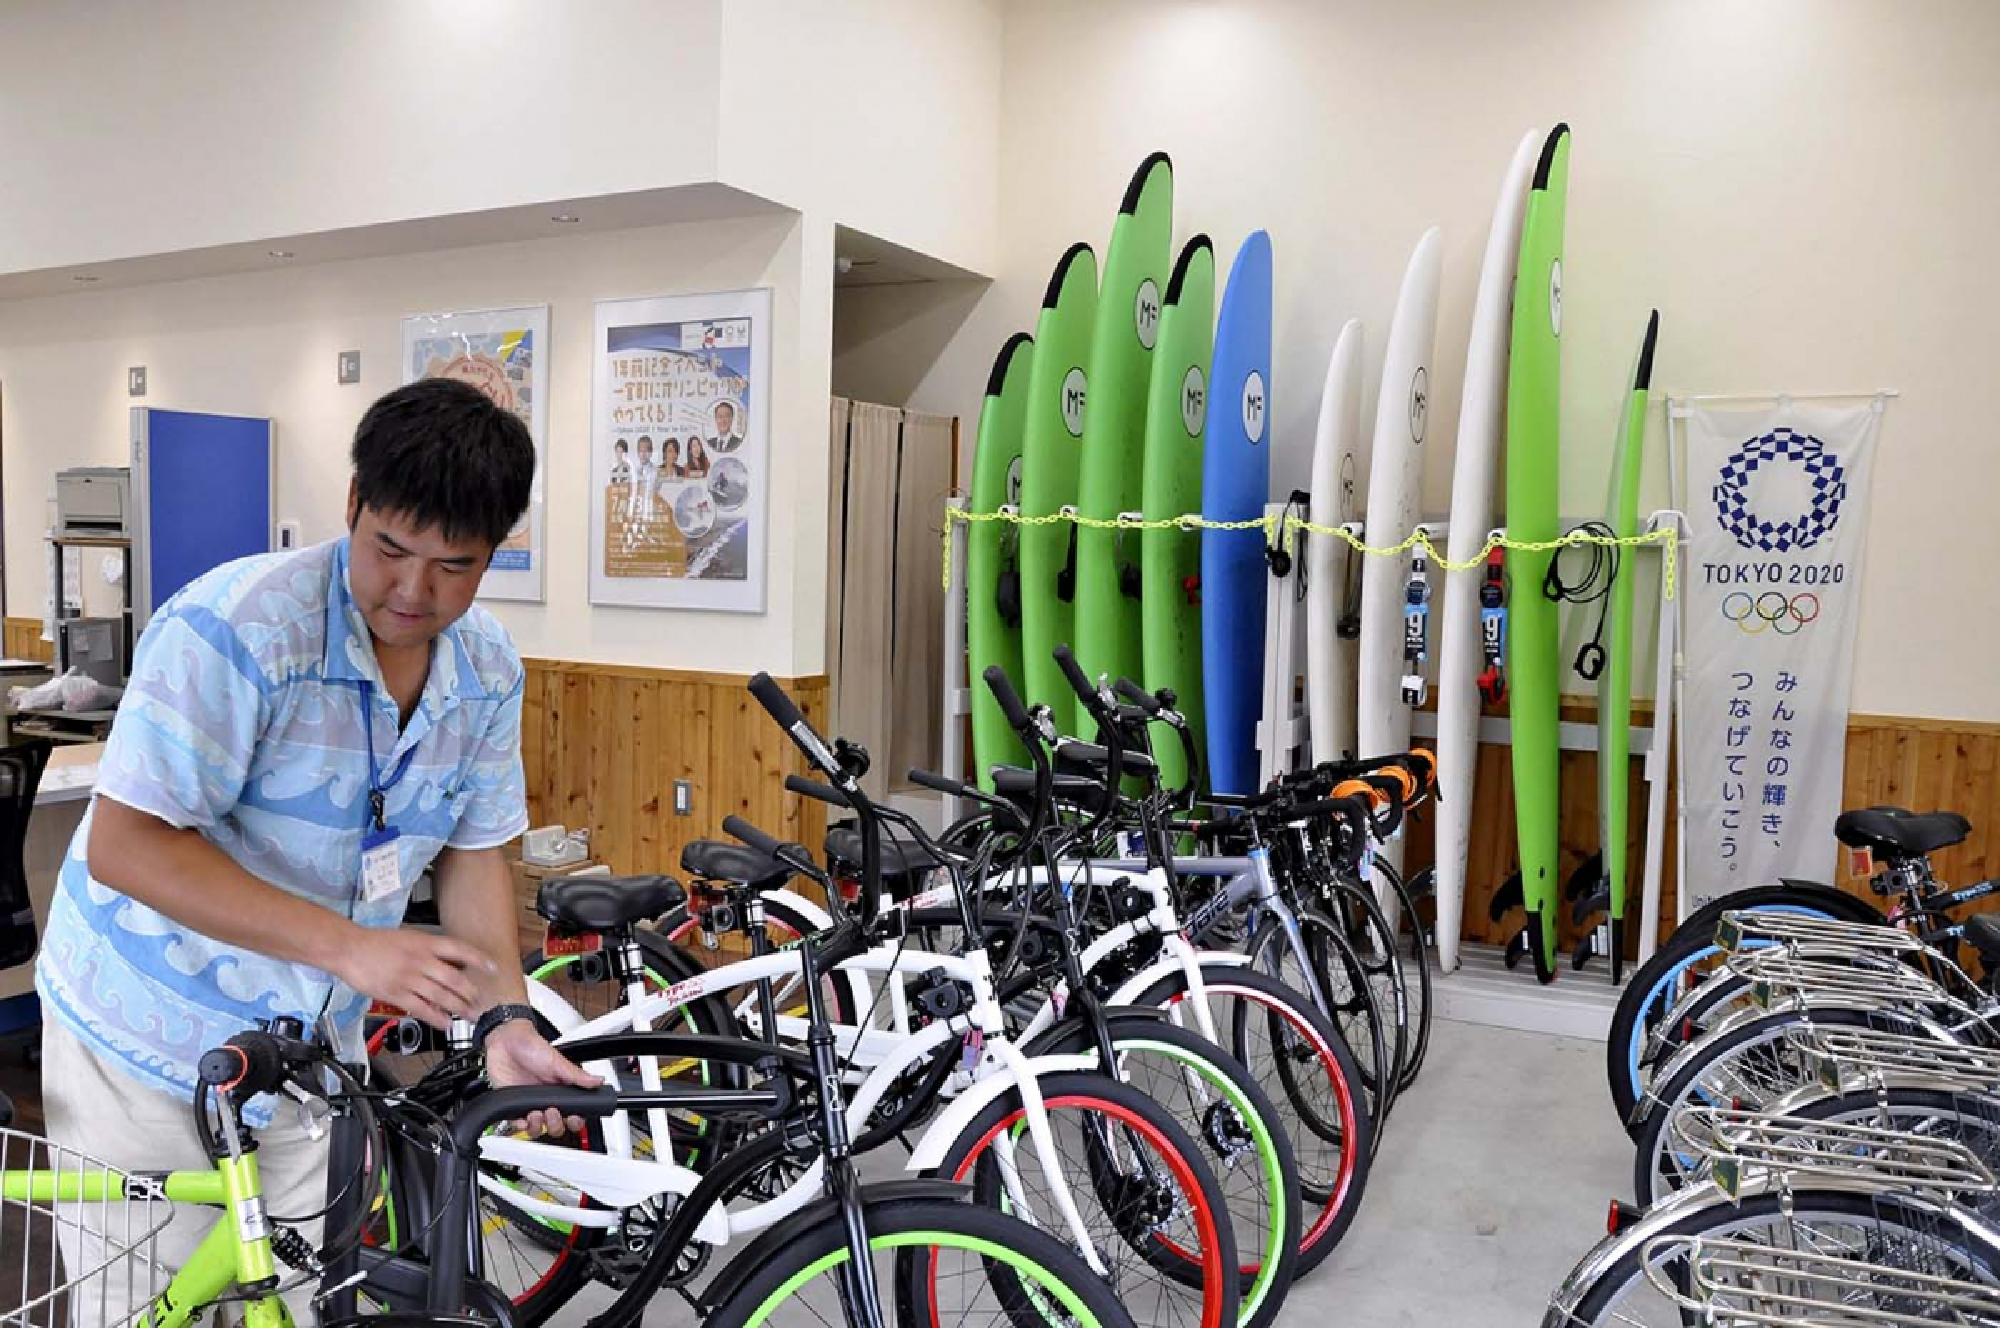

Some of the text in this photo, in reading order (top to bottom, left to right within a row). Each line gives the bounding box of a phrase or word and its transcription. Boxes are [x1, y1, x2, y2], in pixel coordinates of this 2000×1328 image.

[1702, 562, 1844, 586] TOKYO 2020
[1720, 671, 1754, 872] つなげていこう。
[1761, 671, 1798, 848] みんなの輝き、
